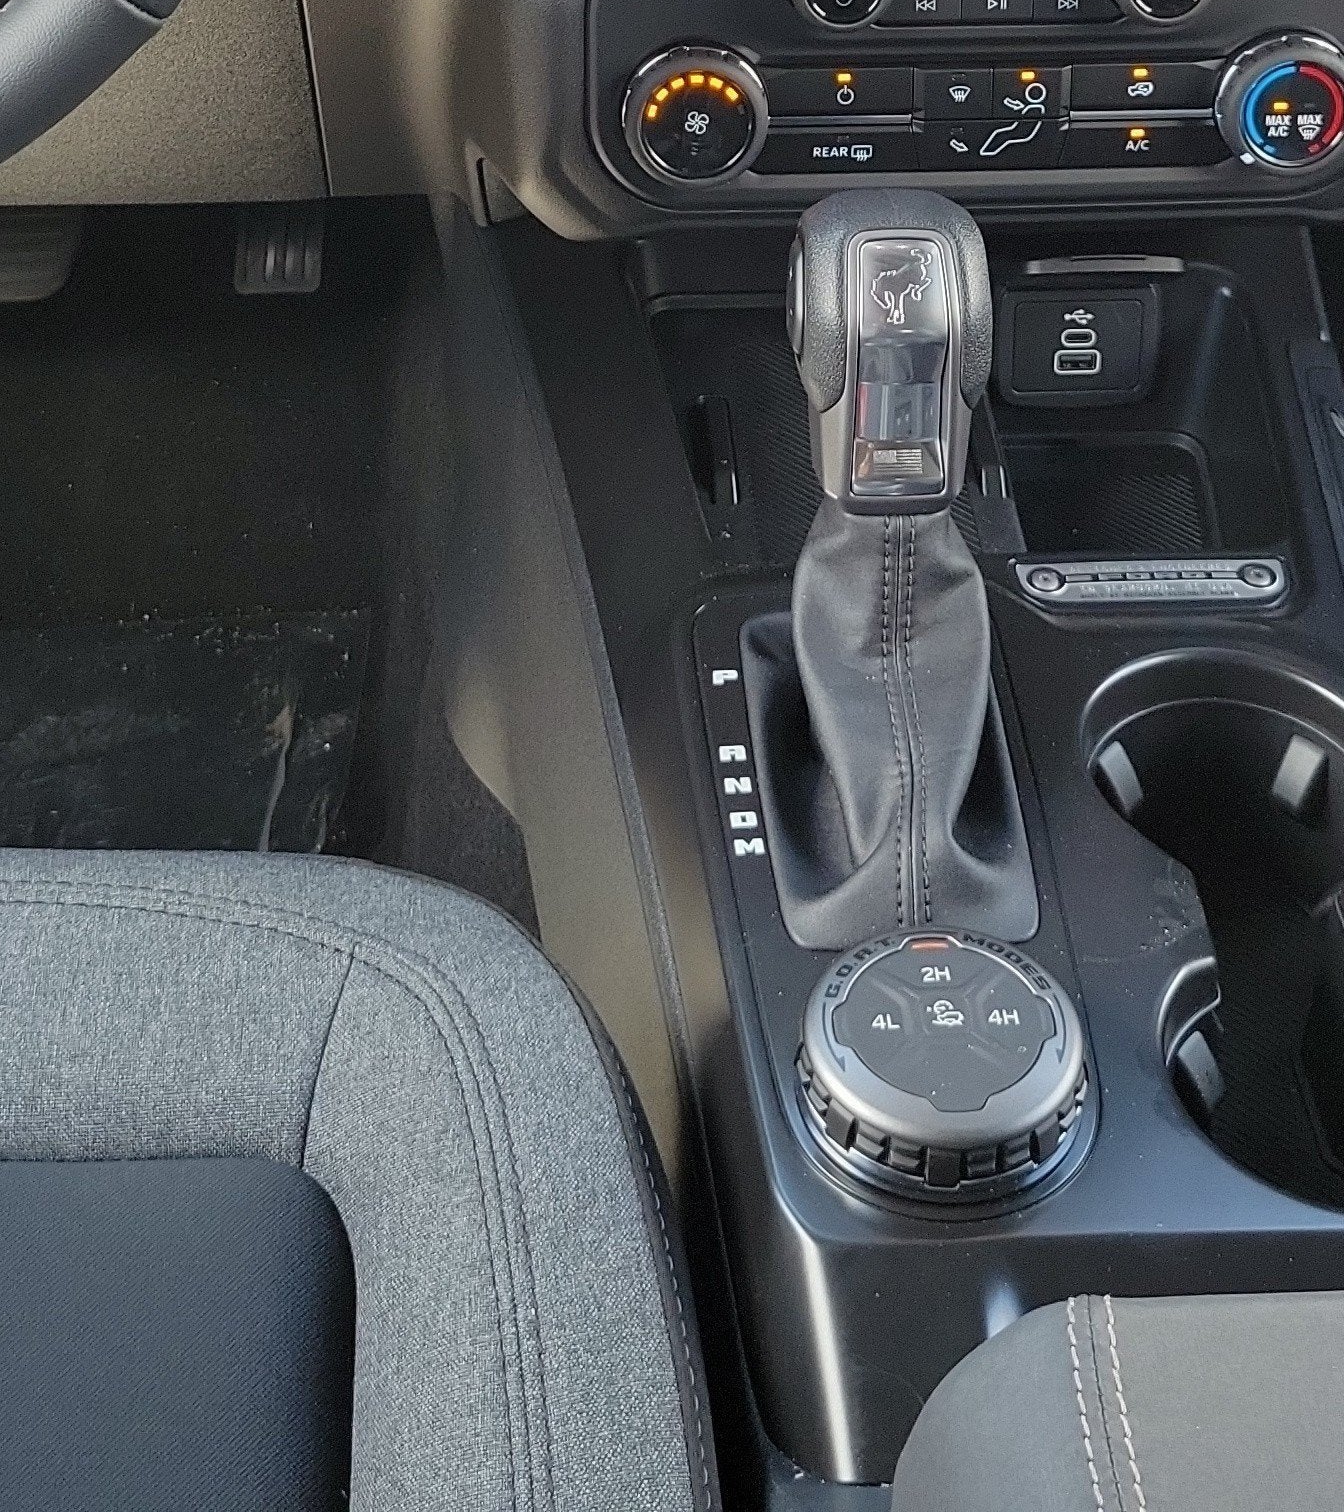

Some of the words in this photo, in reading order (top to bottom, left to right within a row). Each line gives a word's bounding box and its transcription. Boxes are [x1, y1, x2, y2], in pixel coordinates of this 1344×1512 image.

[1266, 115, 1291, 126] MAX
[1297, 114, 1323, 126] MAX
[1267, 126, 1289, 137] A/C
[813, 147, 848, 158] REAR
[1126, 140, 1150, 151] A/C
[712, 669, 739, 685] P
[719, 745, 747, 763] R
[724, 777, 753, 795] N
[729, 811, 758, 829] D
[733, 838, 765, 856] M
[963, 934, 1052, 990] MODES
[920, 966, 951, 982] 2H
[872, 1014, 900, 1029] 4L
[988, 1009, 1020, 1025] 4H
